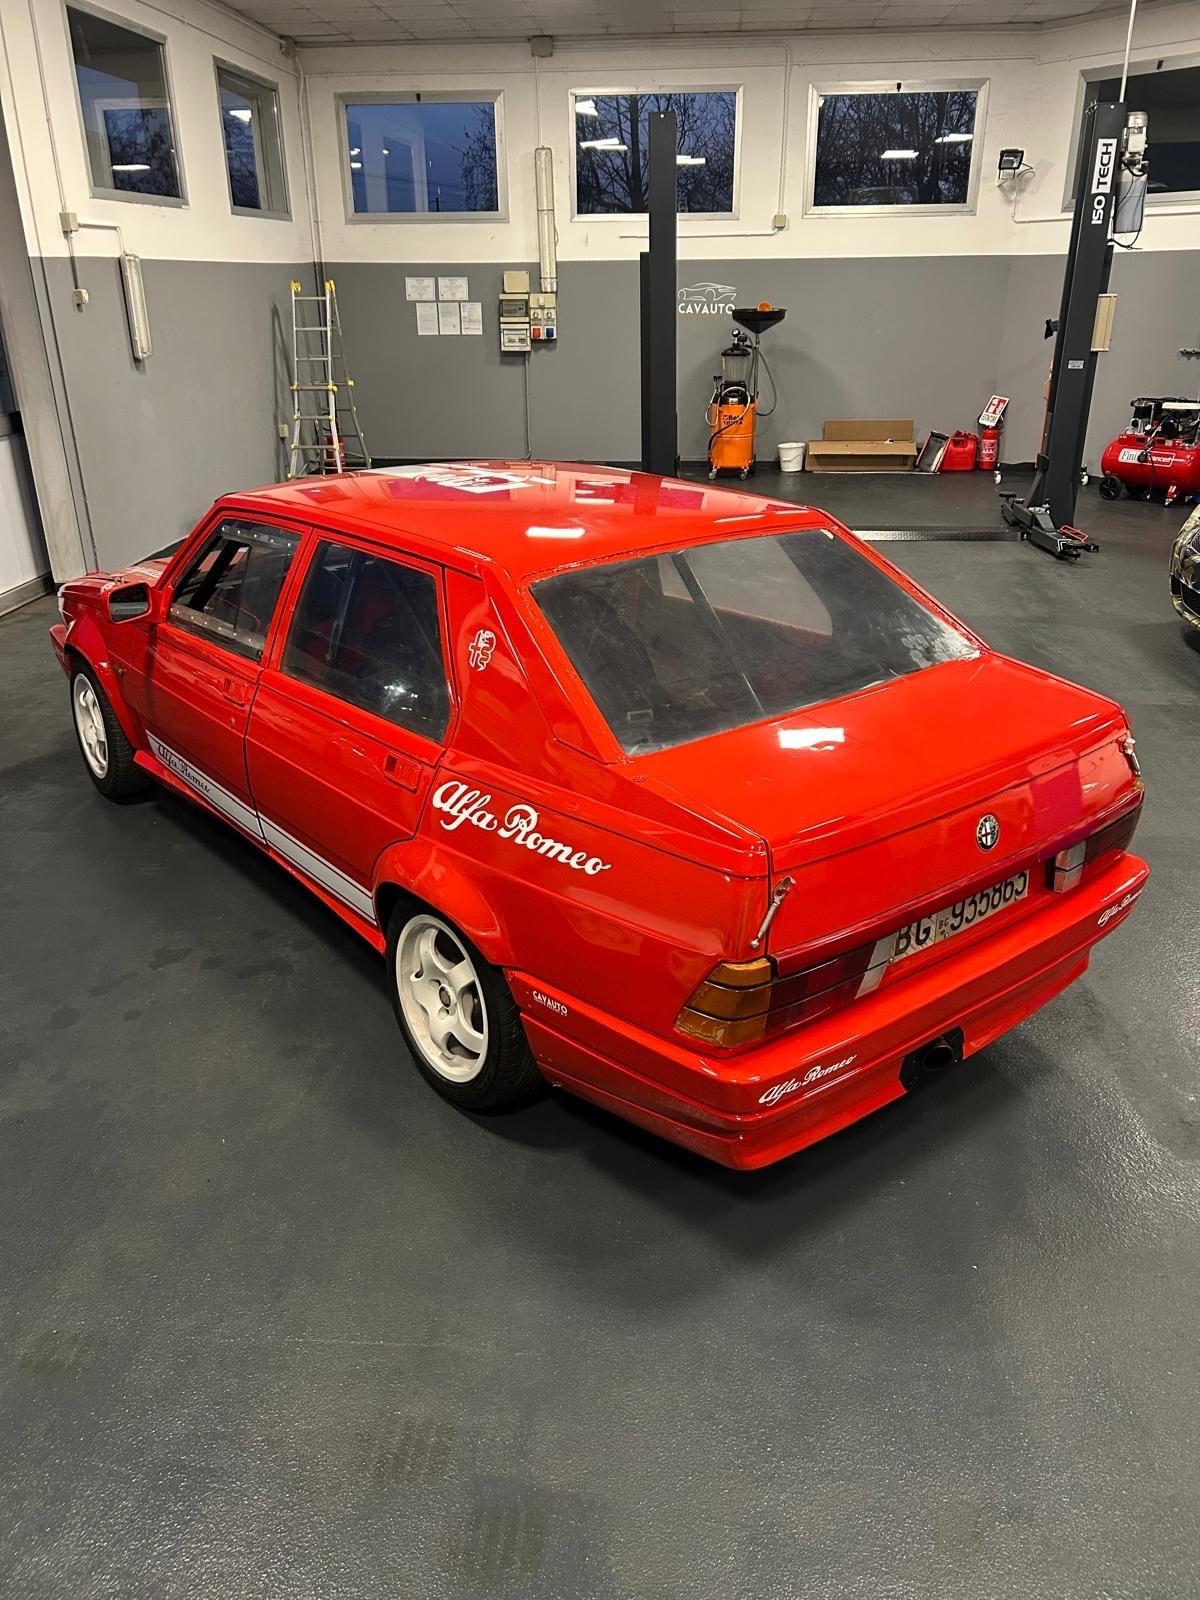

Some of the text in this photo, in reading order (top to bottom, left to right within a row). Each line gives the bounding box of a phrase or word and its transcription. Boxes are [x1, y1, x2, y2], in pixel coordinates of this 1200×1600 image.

[1091, 142, 1113, 225] ISO TECH
[678, 303, 735, 315] CAVAUTO
[432, 780, 612, 875] Alfa Romeo
[894, 917, 932, 957] BG
[532, 990, 568, 1014] CAVAUTO
[758, 1054, 858, 1107] Alfa Romeo
